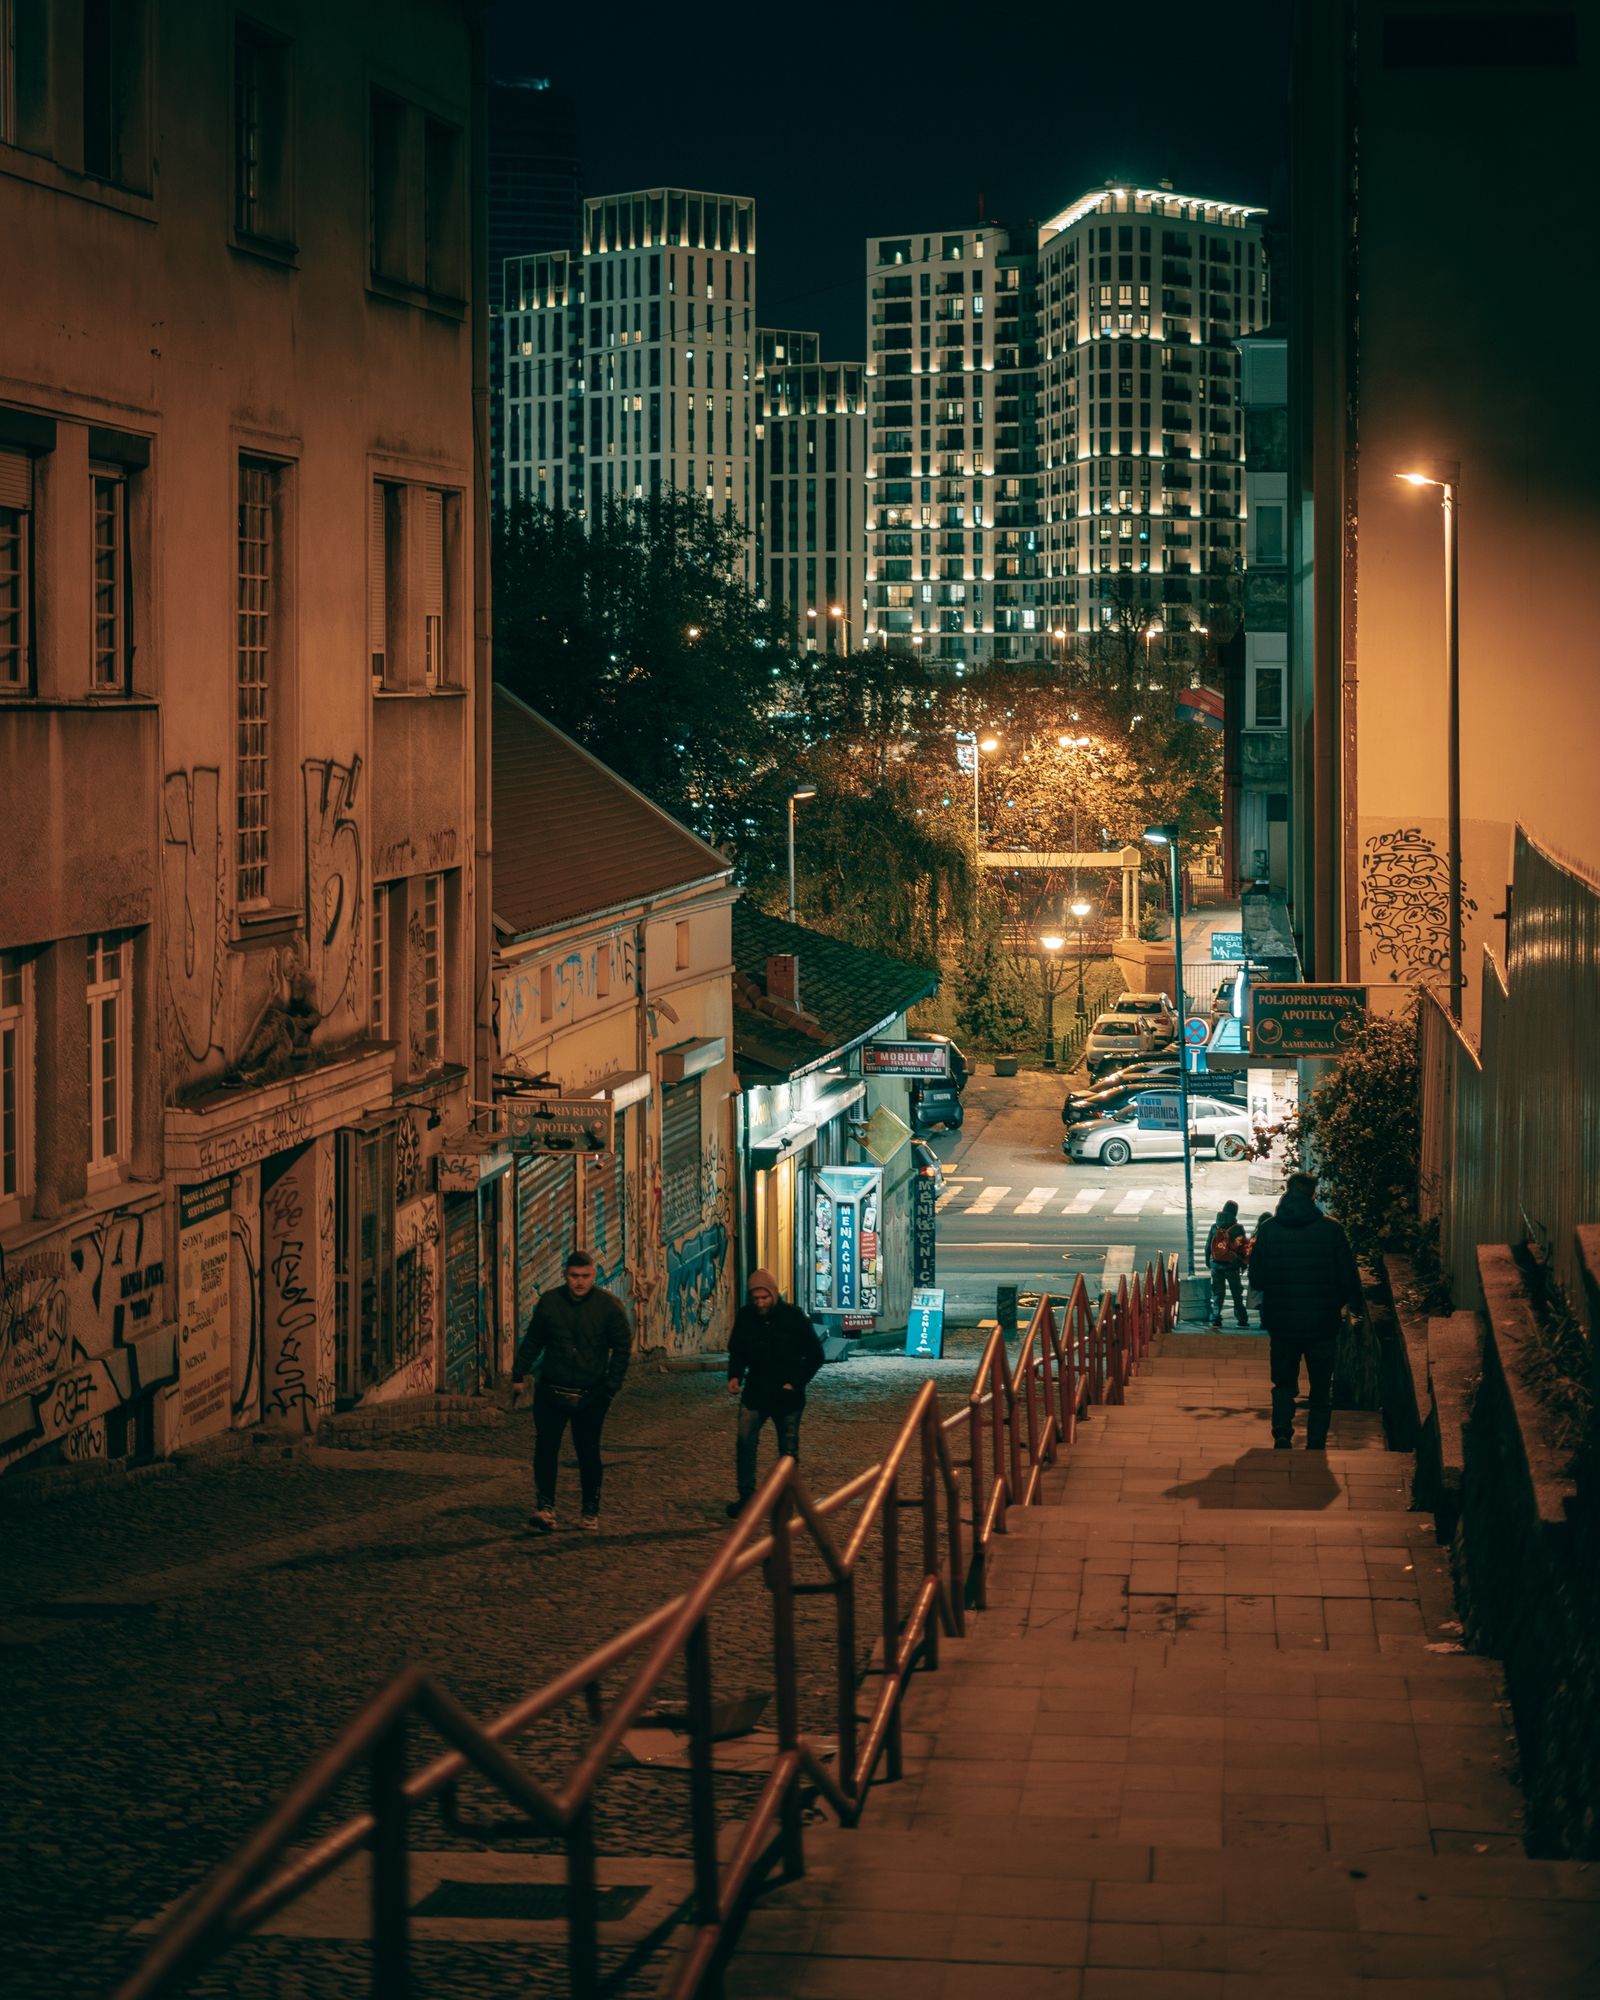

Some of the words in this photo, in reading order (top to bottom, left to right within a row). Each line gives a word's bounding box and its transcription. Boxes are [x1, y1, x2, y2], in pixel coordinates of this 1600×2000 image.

[1258, 995, 1358, 1005] POLJOPRIVREDNA
[1281, 1010, 1335, 1020] APOTEKA
[880, 1052, 928, 1062] MOBILNI
[513, 1105, 608, 1117] POLPRIVREDNA
[1139, 1106, 1179, 1119] KOPIRNICA
[534, 1123, 585, 1133] APOTEKA
[181, 1231, 203, 1250] SONY
[185, 1351, 207, 1370] NOKIA
